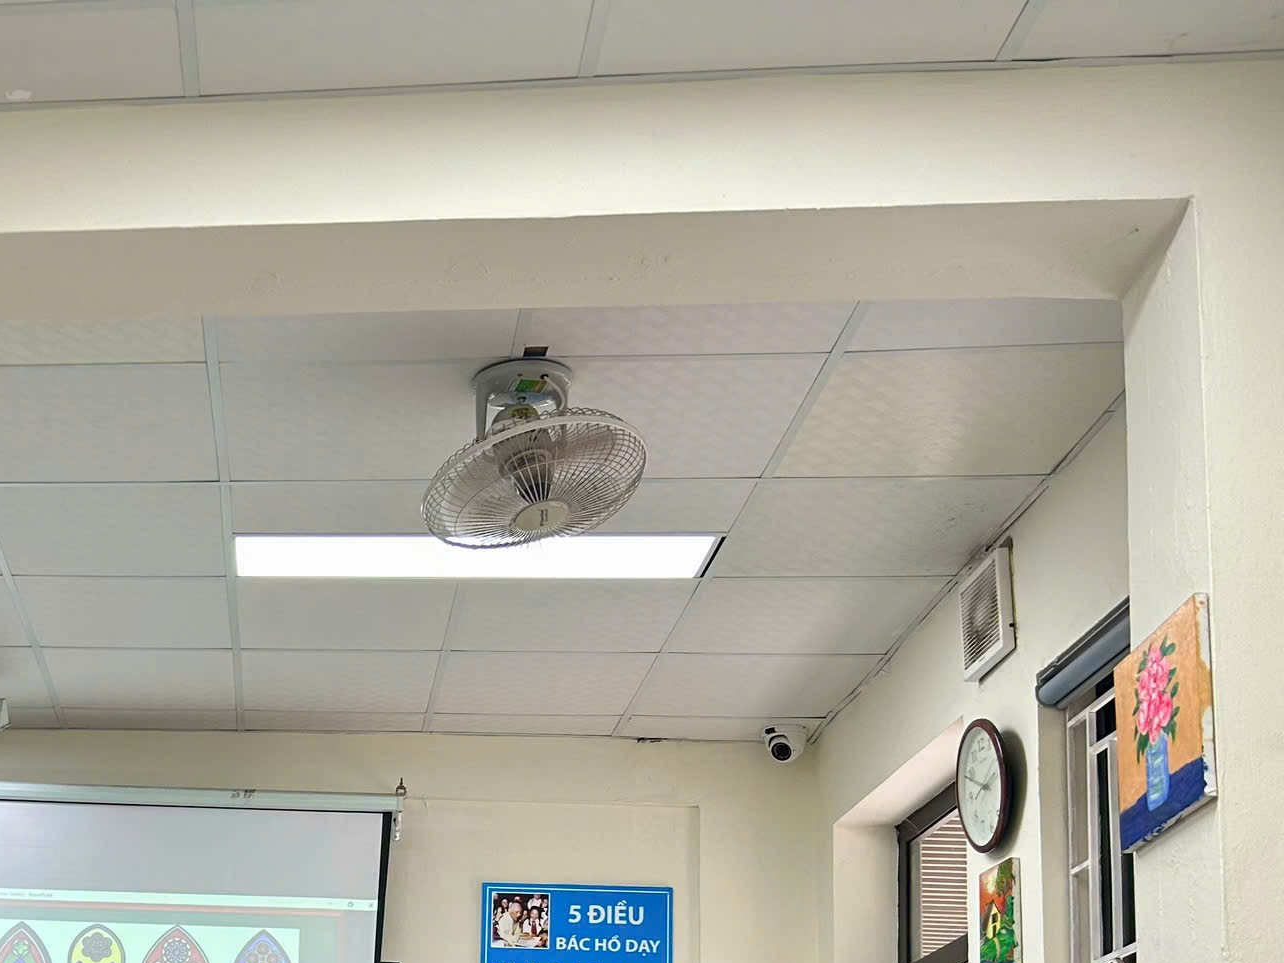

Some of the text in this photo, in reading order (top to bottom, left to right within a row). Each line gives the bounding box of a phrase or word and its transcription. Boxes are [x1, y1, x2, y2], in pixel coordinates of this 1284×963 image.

[568, 900, 644, 925] 5 ĐIỀU
[555, 935, 661, 957] BÁC HỒ DẠY
